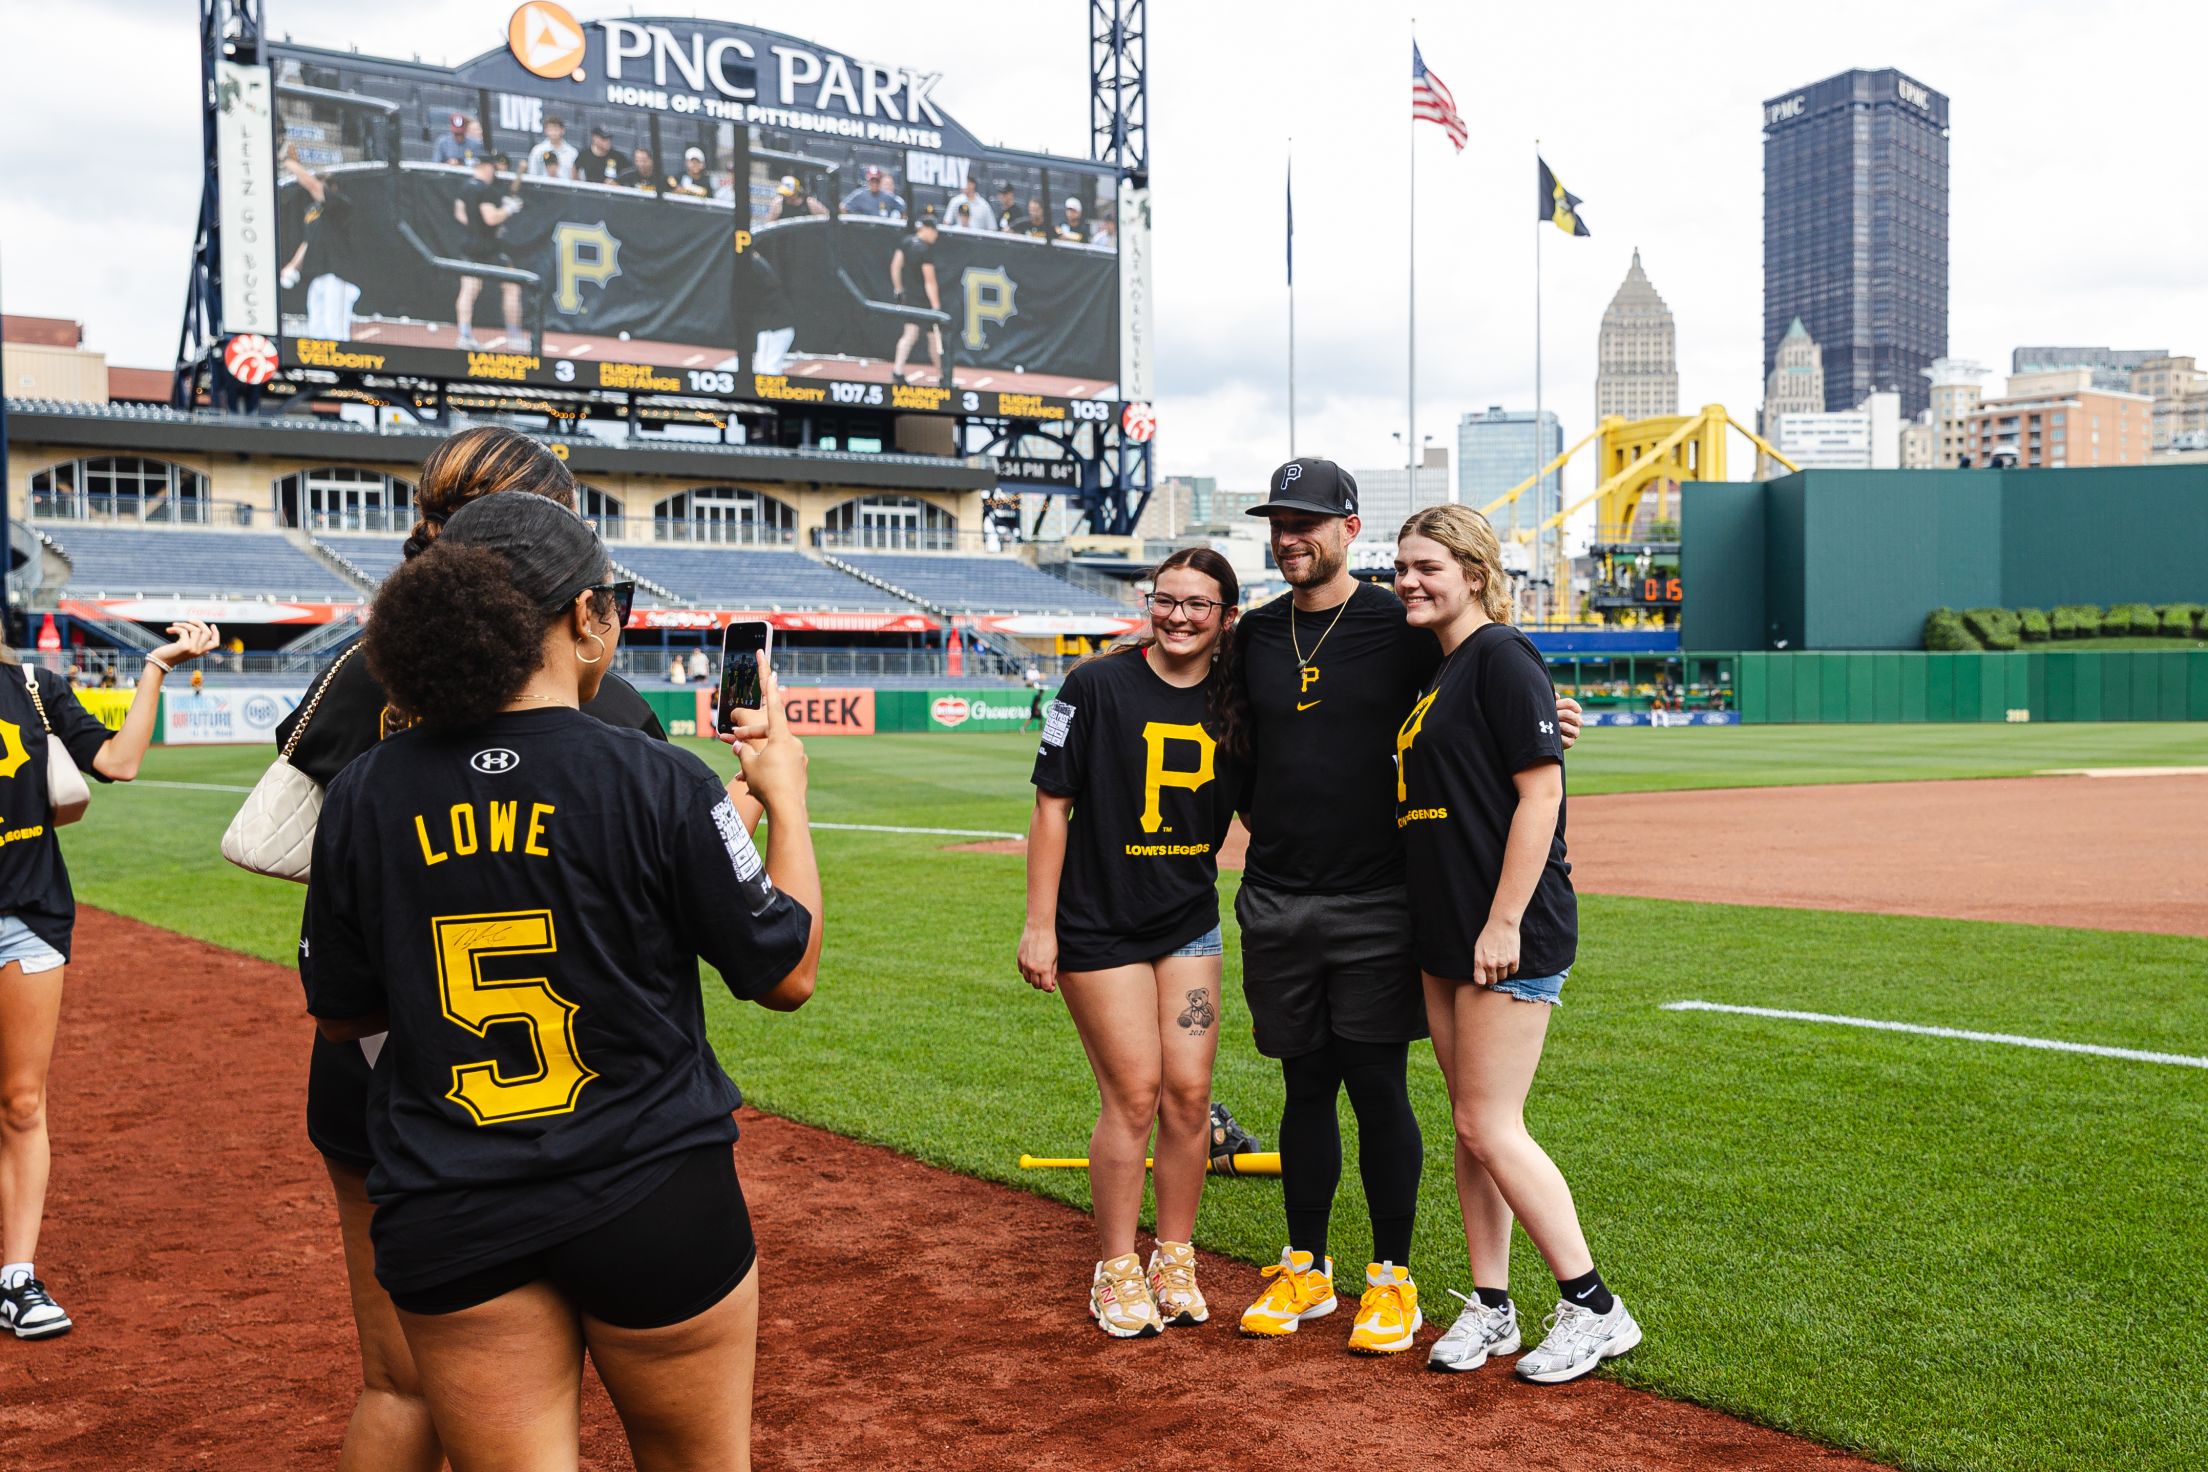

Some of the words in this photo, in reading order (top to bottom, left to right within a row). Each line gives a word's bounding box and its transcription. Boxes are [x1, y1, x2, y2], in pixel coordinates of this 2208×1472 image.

[597, 20, 756, 98] PNC
[771, 45, 944, 126] PARK
[1898, 78, 1931, 111] UPMC
[499, 92, 543, 133] LIVE
[607, 84, 668, 110] HOME
[671, 94, 701, 114] OF
[703, 98, 744, 121] THE
[746, 104, 865, 138] PITTSBURGH
[867, 122, 942, 149] PIRATES
[906, 150, 970, 190] REPLAY
[297, 338, 338, 353] EXIT
[297, 351, 386, 370] VELOCITY
[467, 352, 540, 370] LAUNCH
[599, 362, 655, 378] FLIGHT
[467, 364, 527, 380] ANGLE
[554, 360, 576, 383] 3
[687, 370, 735, 393] 103
[755, 375, 789, 387] EXIT
[600, 374, 681, 392] DISTANCE
[755, 384, 826, 401] VELOCITY
[830, 382, 884, 405] 107.5
[891, 385, 951, 401] LAUNCH
[892, 396, 940, 411] ANGLE
[962, 391, 980, 412] 3
[998, 392, 1043, 408] FLIGHT
[1070, 400, 1110, 421] 103
[998, 404, 1065, 420] DISTANCE
[1022, 462, 1045, 478] PM
[1281, 464, 1302, 490] P
[1301, 667, 1320, 692] P
[1140, 722, 1217, 832] P
[415, 801, 555, 866] LOWE
[431, 909, 600, 1126] 5
